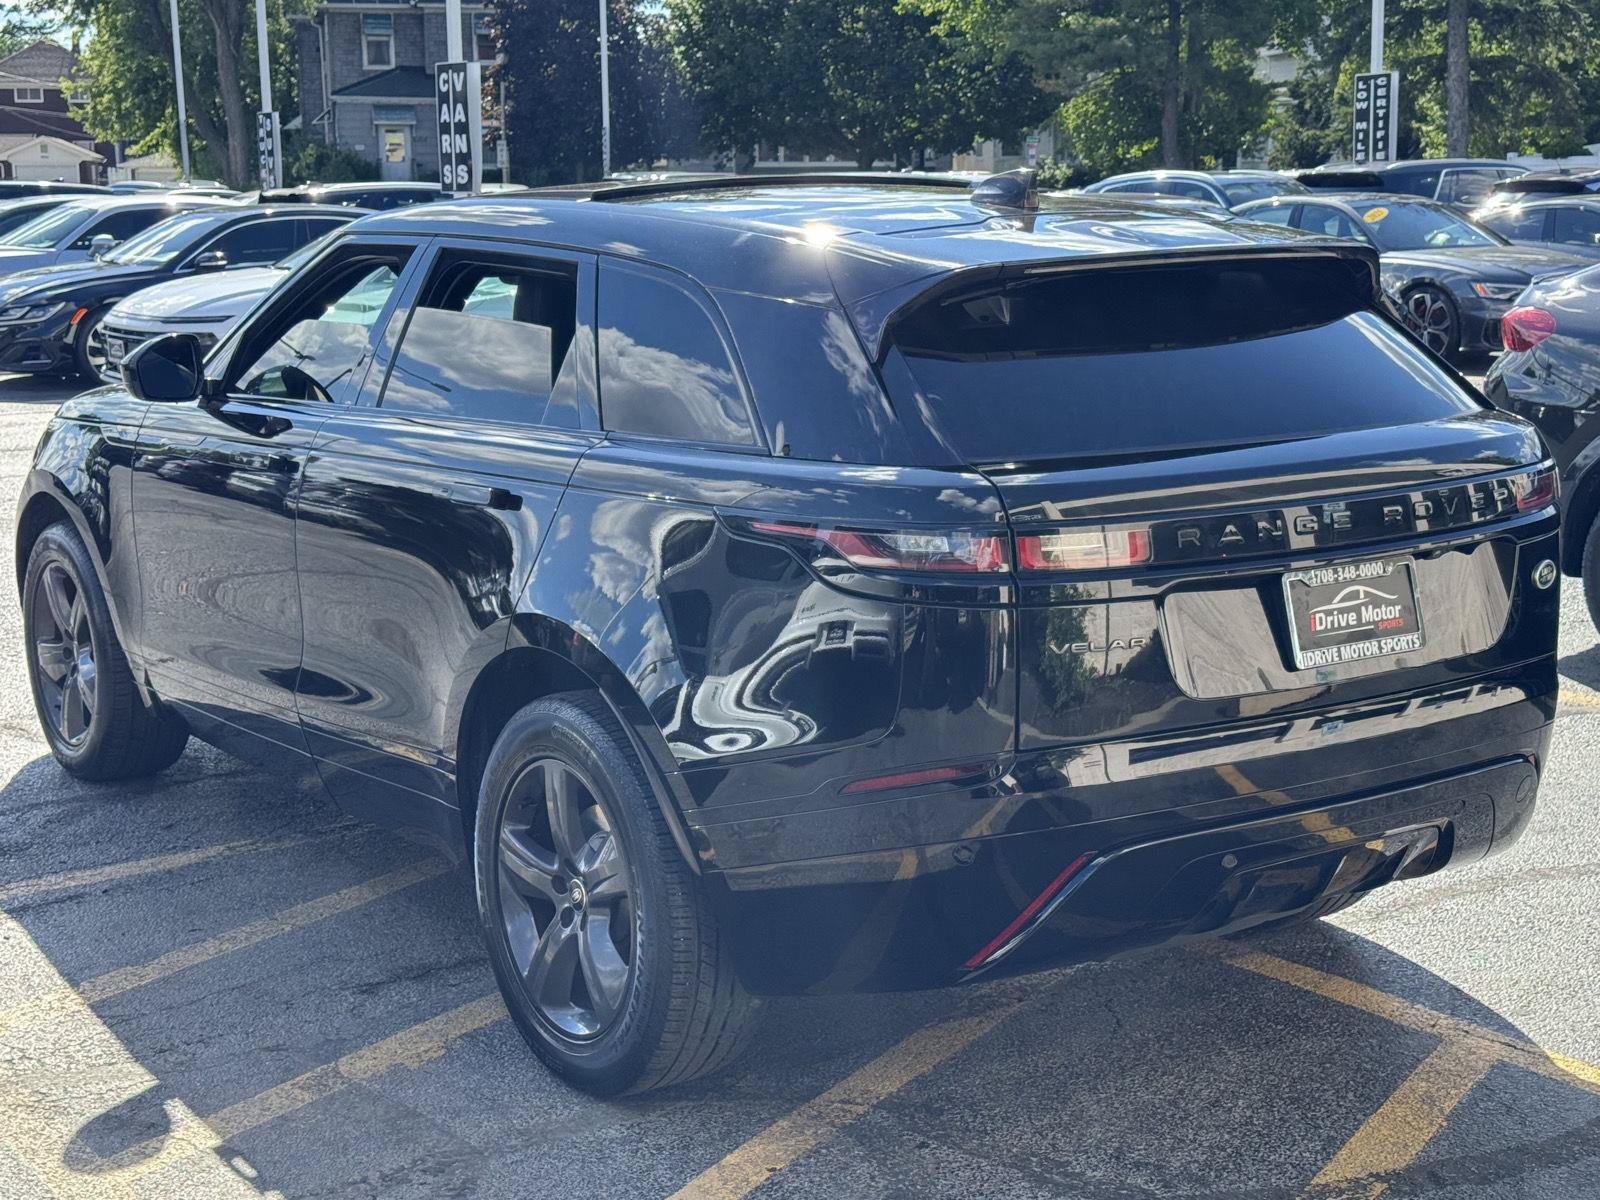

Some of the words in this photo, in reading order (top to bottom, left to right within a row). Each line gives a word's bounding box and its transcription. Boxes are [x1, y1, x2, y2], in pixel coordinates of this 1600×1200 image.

[1356, 80, 1368, 110] LOW
[439, 72, 452, 184] CARS
[452, 72, 469, 184] VANS
[1177, 511, 1352, 548] RANGE
[1383, 487, 1509, 520] ROVER
[1315, 561, 1384, 584] 708-348-0000
[1310, 611, 1357, 633] iDrive
[1361, 604, 1402, 624] Motor
[1376, 617, 1404, 630] SPORTS
[1048, 638, 1146, 655] VELAR
[1340, 640, 1380, 661] MOTOR
[1380, 634, 1420, 654] SPORTS
